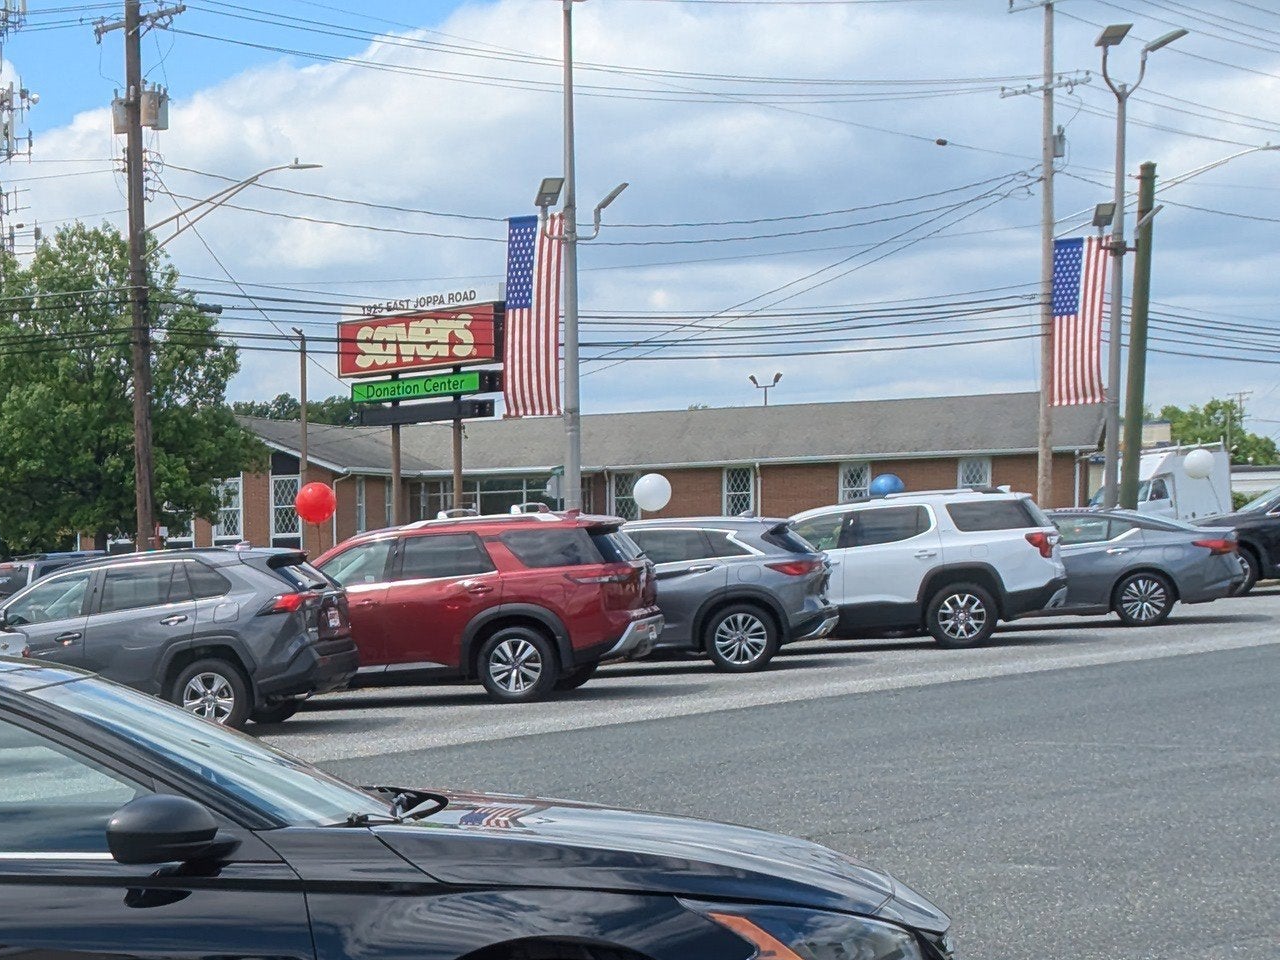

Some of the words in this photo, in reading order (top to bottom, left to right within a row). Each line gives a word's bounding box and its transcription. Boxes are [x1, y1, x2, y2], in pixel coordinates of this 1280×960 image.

[361, 303, 384, 316] 1925
[387, 299, 411, 311] EAST
[414, 293, 446, 308] JOPPA
[448, 290, 477, 303] ROAD
[366, 381, 420, 399] Donation
[424, 377, 465, 394] Center
